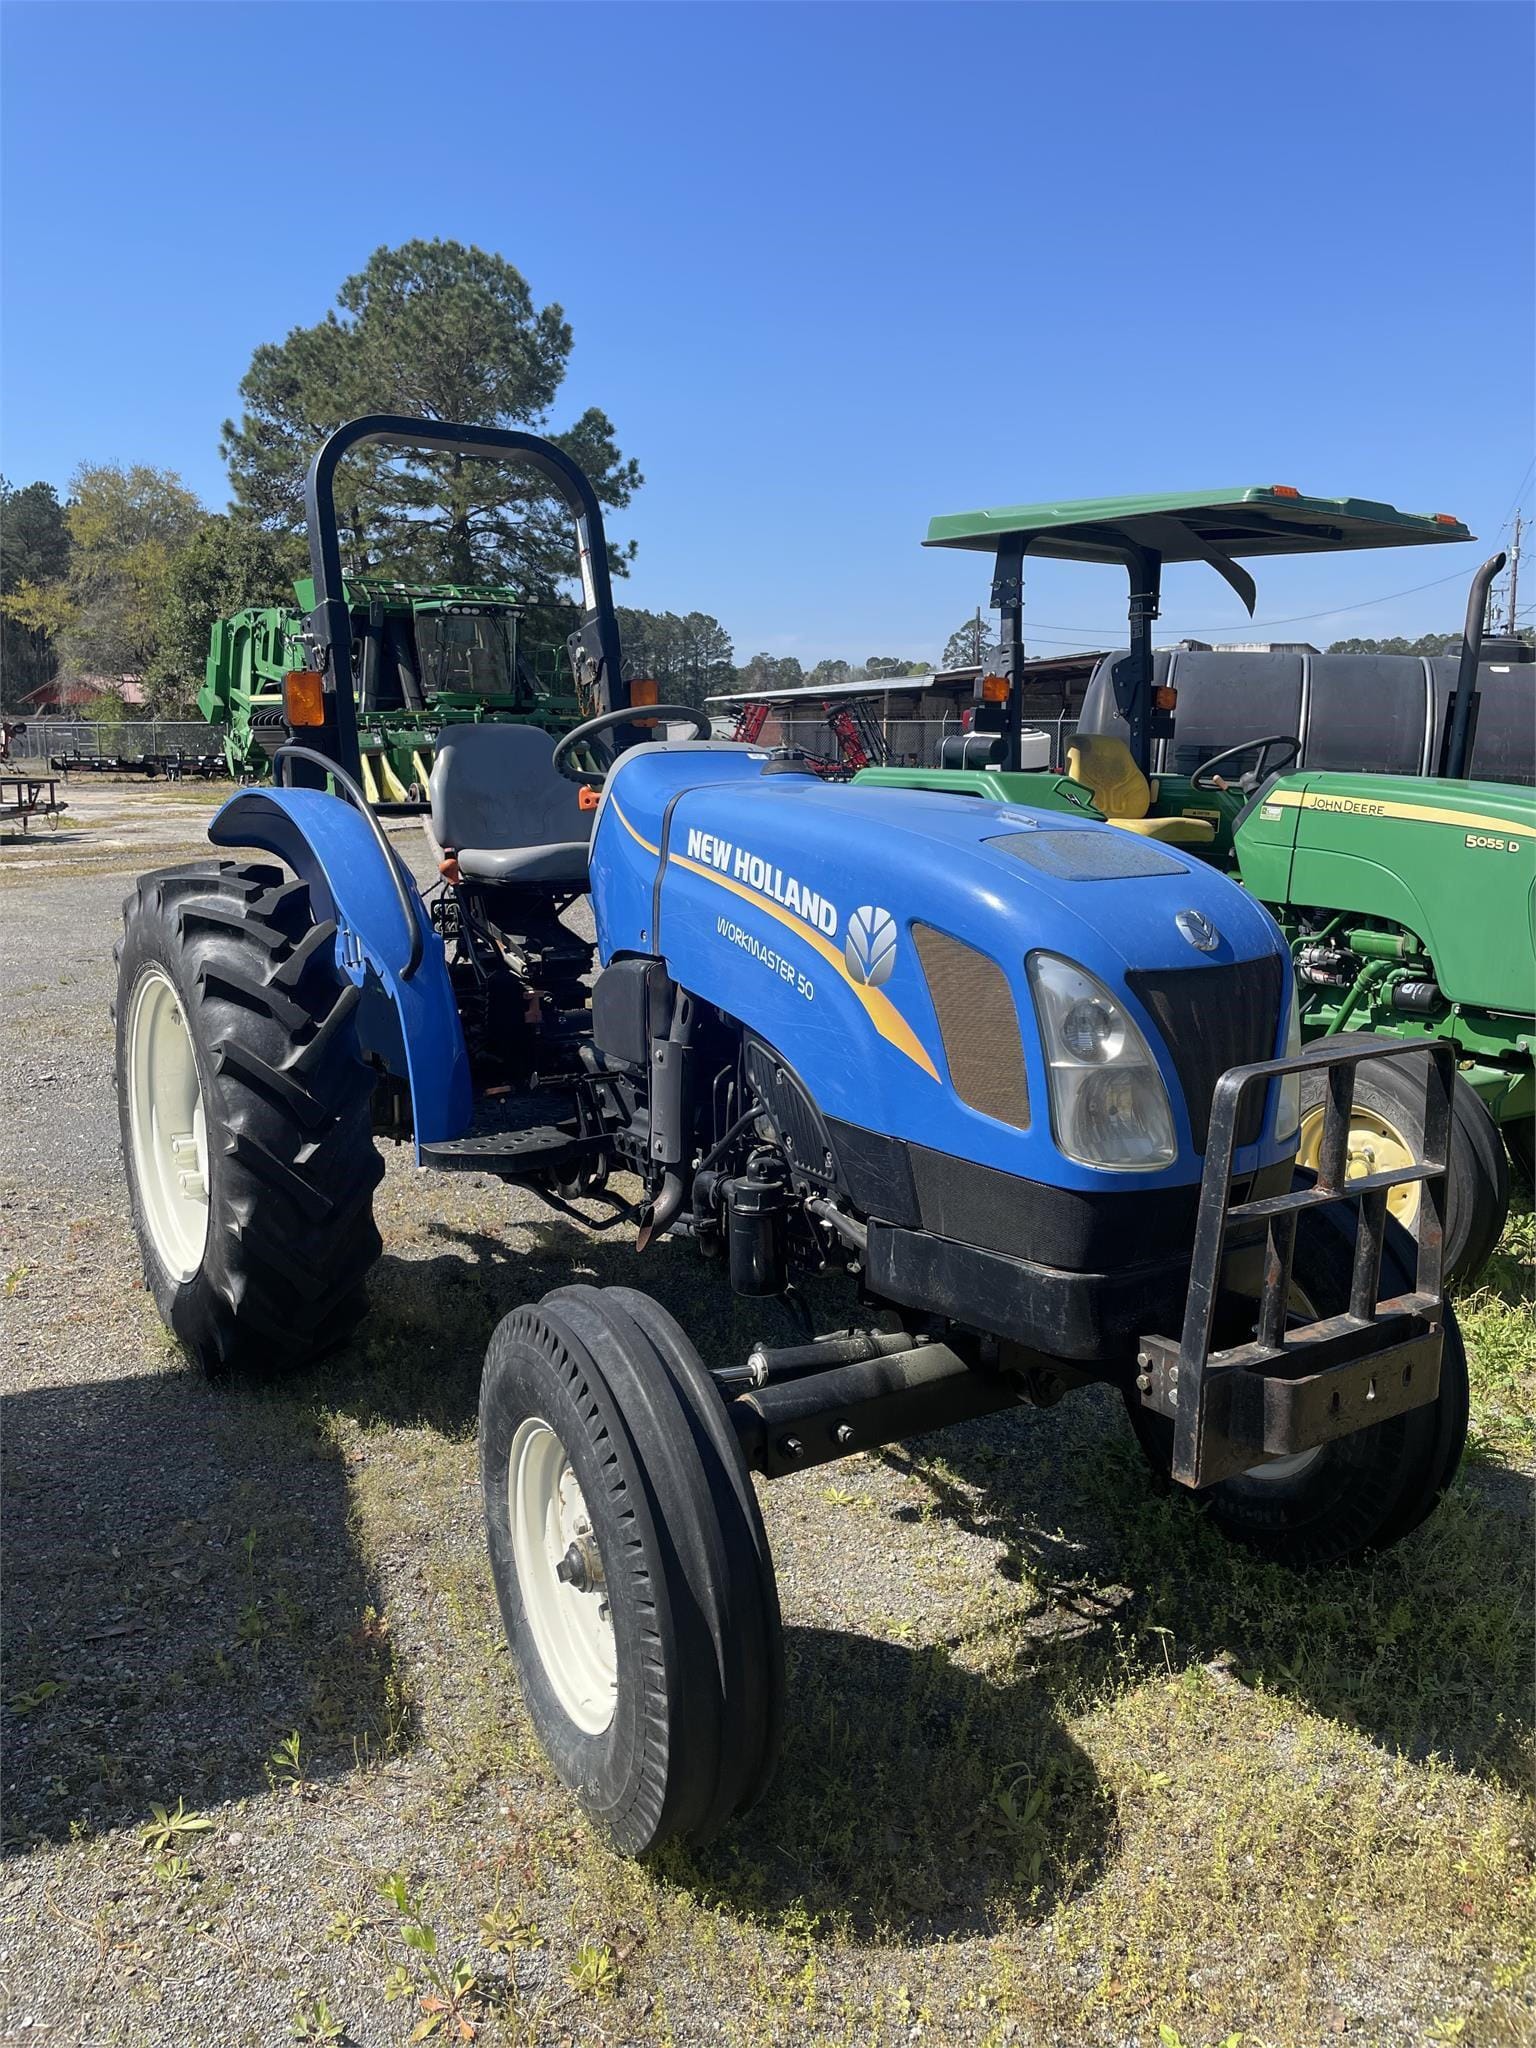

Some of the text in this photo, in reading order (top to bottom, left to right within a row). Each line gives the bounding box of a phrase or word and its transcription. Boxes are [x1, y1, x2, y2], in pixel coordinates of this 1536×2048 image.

[1309, 796, 1385, 816] JOHN DEERE
[1464, 834, 1520, 853] 5055 D
[687, 828, 838, 937] NEW HOLLAND
[716, 916, 815, 1002] WORKMASTER 50
